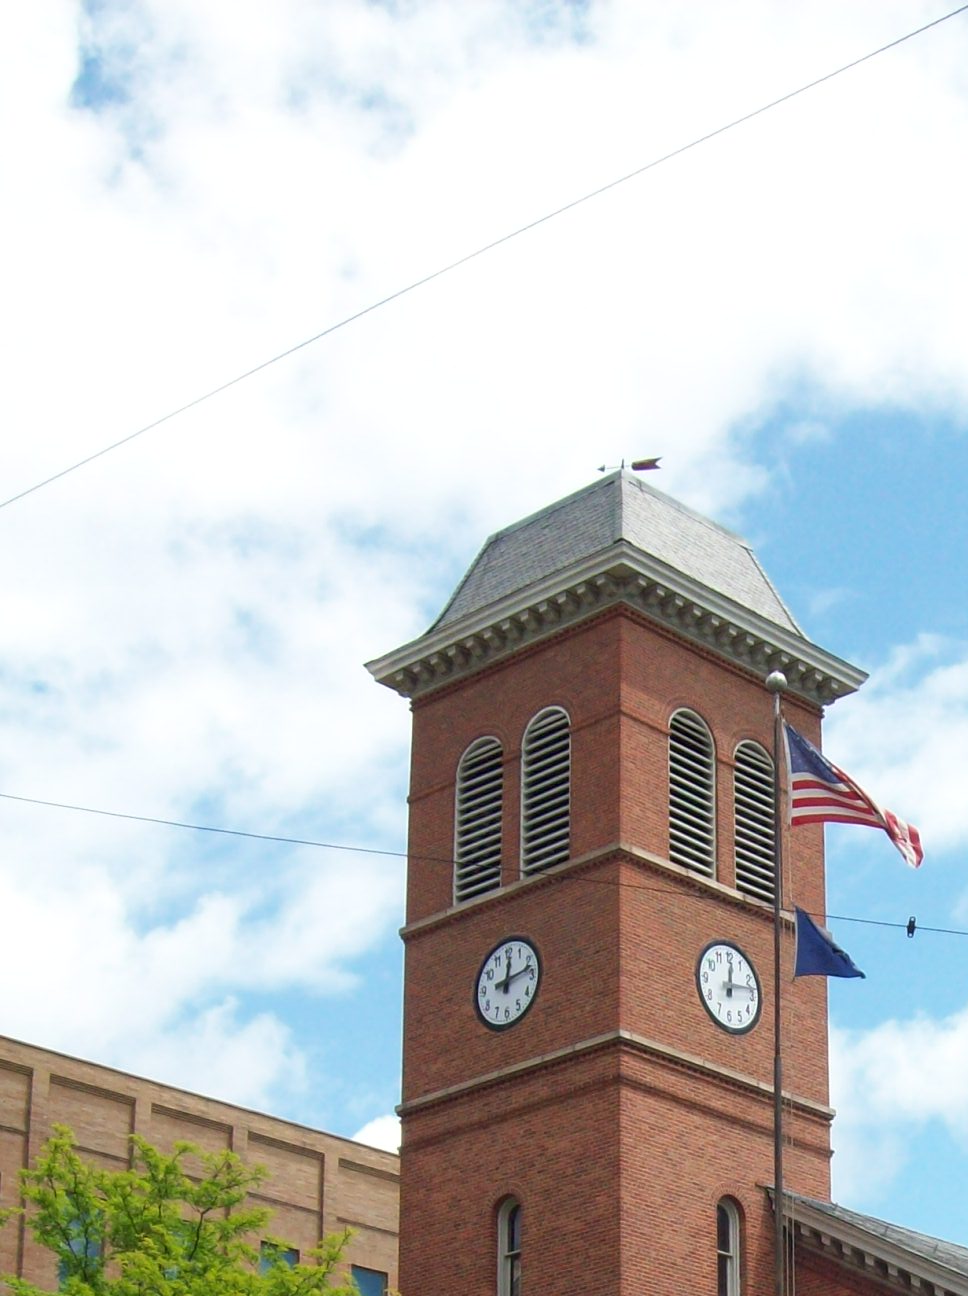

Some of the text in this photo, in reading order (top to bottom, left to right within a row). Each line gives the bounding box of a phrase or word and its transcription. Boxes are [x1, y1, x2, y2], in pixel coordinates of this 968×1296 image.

[505, 948, 513, 959] 12
[715, 951, 722, 964] 11
[726, 952, 733, 964] 12
[494, 955, 501, 968] 11
[708, 958, 715, 971] 10
[484, 969, 494, 981] 10
[529, 968, 535, 980] 3
[703, 971, 708, 983] 9
[746, 974, 753, 988] 2
[480, 986, 487, 998] 9
[525, 985, 531, 997] 4
[707, 989, 712, 1000] 8
[749, 989, 755, 1001] 3
[485, 1000, 490, 1012] 8
[516, 999, 521, 1012] 5
[717, 1002, 722, 1016] 7
[745, 1004, 750, 1015] 4
[504, 1007, 510, 1019] 6
[727, 1010, 732, 1022] 6
[737, 1010, 742, 1022] 5
